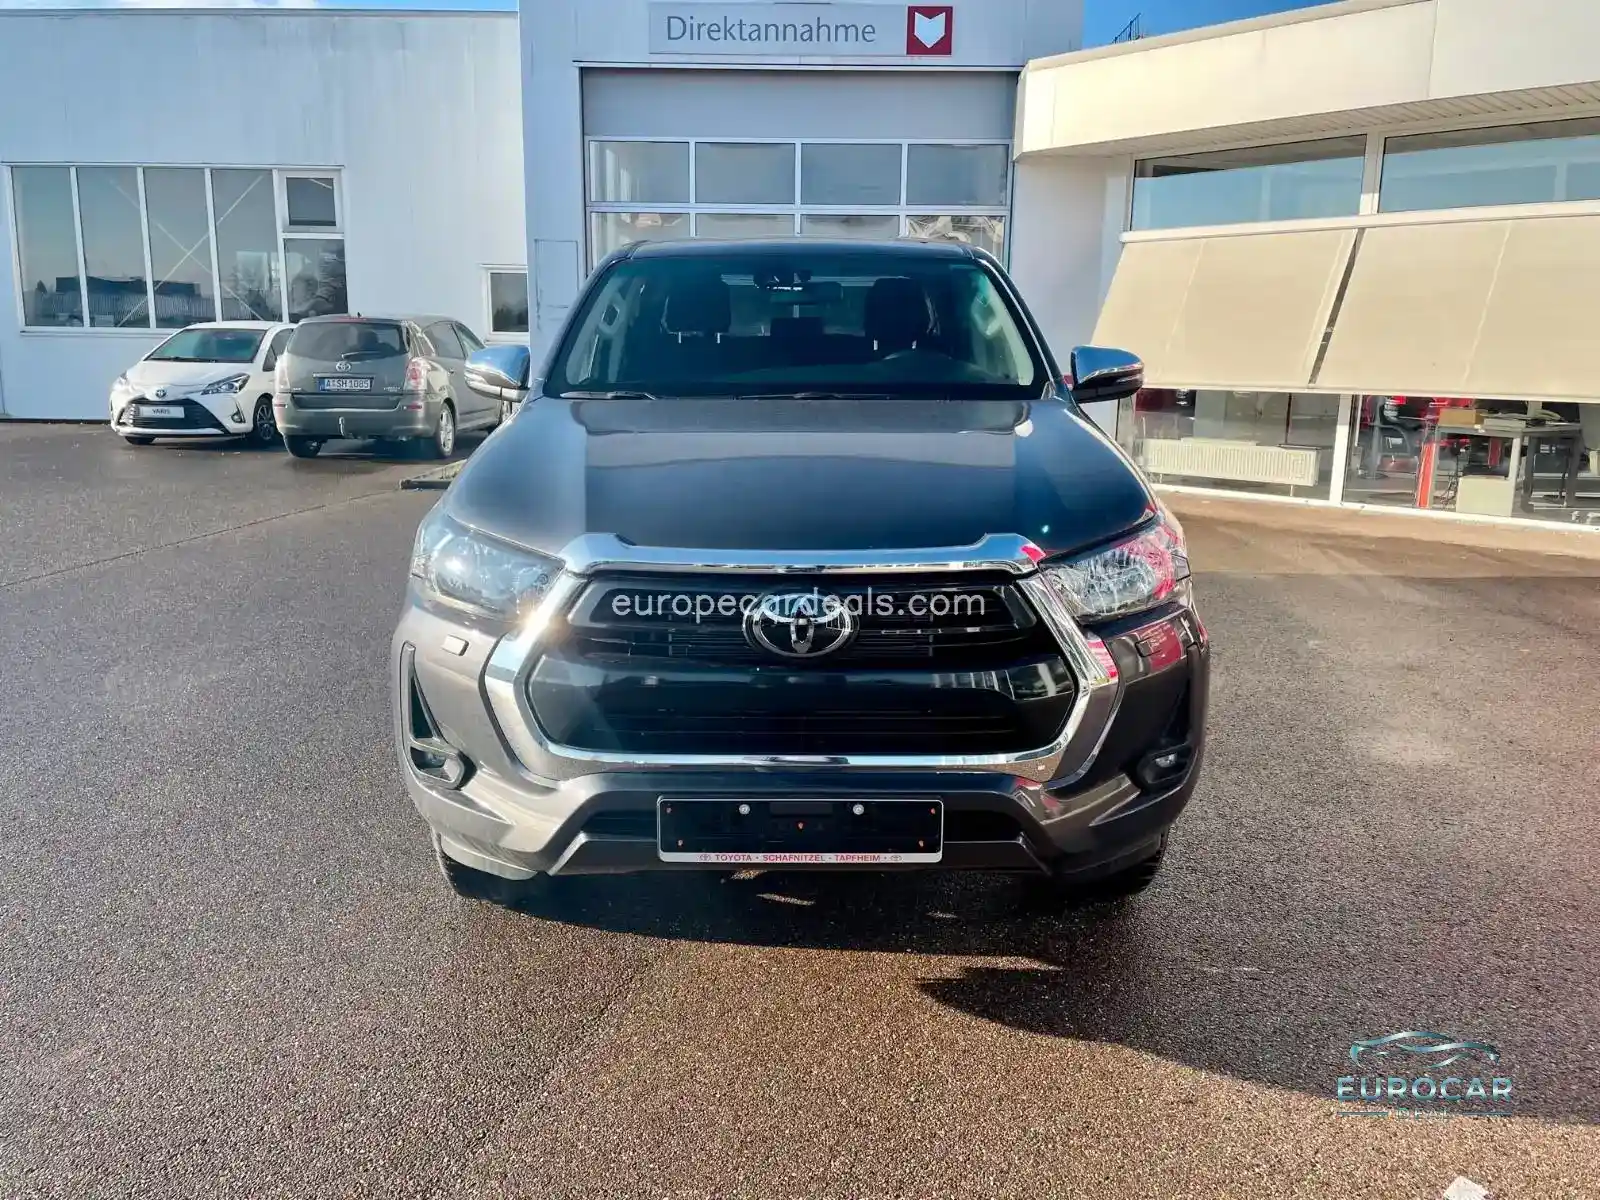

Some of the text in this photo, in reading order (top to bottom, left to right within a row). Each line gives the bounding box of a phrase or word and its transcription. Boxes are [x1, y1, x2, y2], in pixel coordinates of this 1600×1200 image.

[666, 15, 876, 43] Direktannahme
[715, 854, 752, 862] TOYOTA
[834, 854, 880, 862] TAPFHEIM
